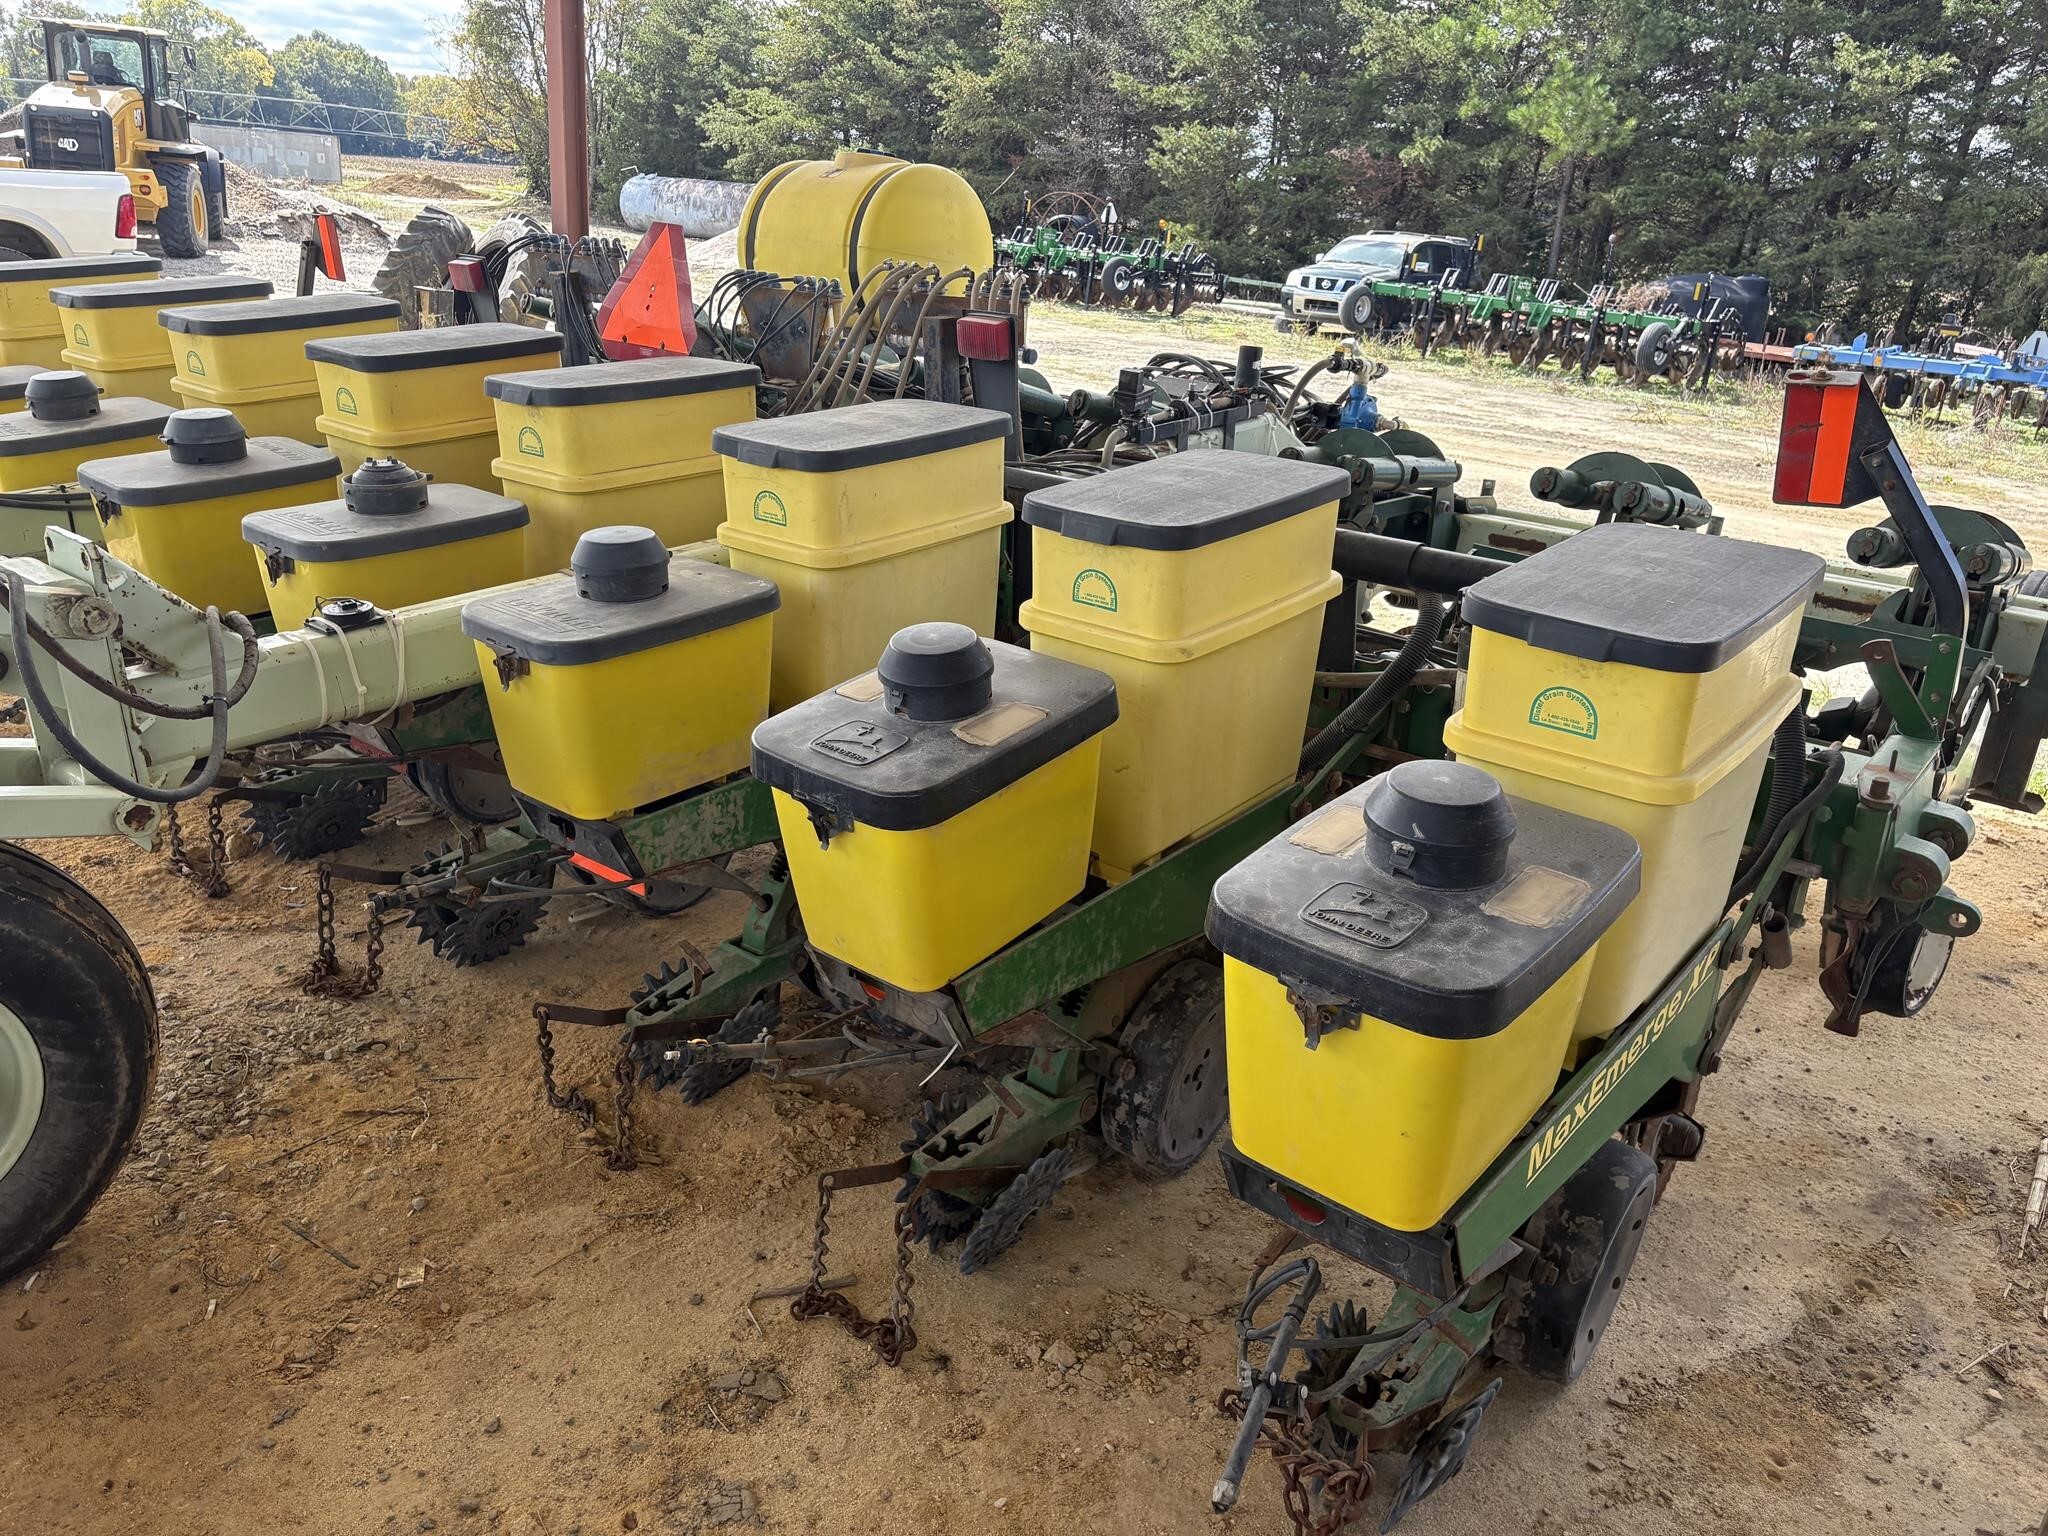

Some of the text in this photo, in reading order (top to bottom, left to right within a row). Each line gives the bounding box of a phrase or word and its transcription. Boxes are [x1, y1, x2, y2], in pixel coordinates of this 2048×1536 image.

[58, 137, 77, 151] CAT
[1543, 691, 1564, 701] Grain
[1308, 909, 1391, 943] JOHN DEERE
[1526, 940, 1721, 1181] MaxEmerge XP
